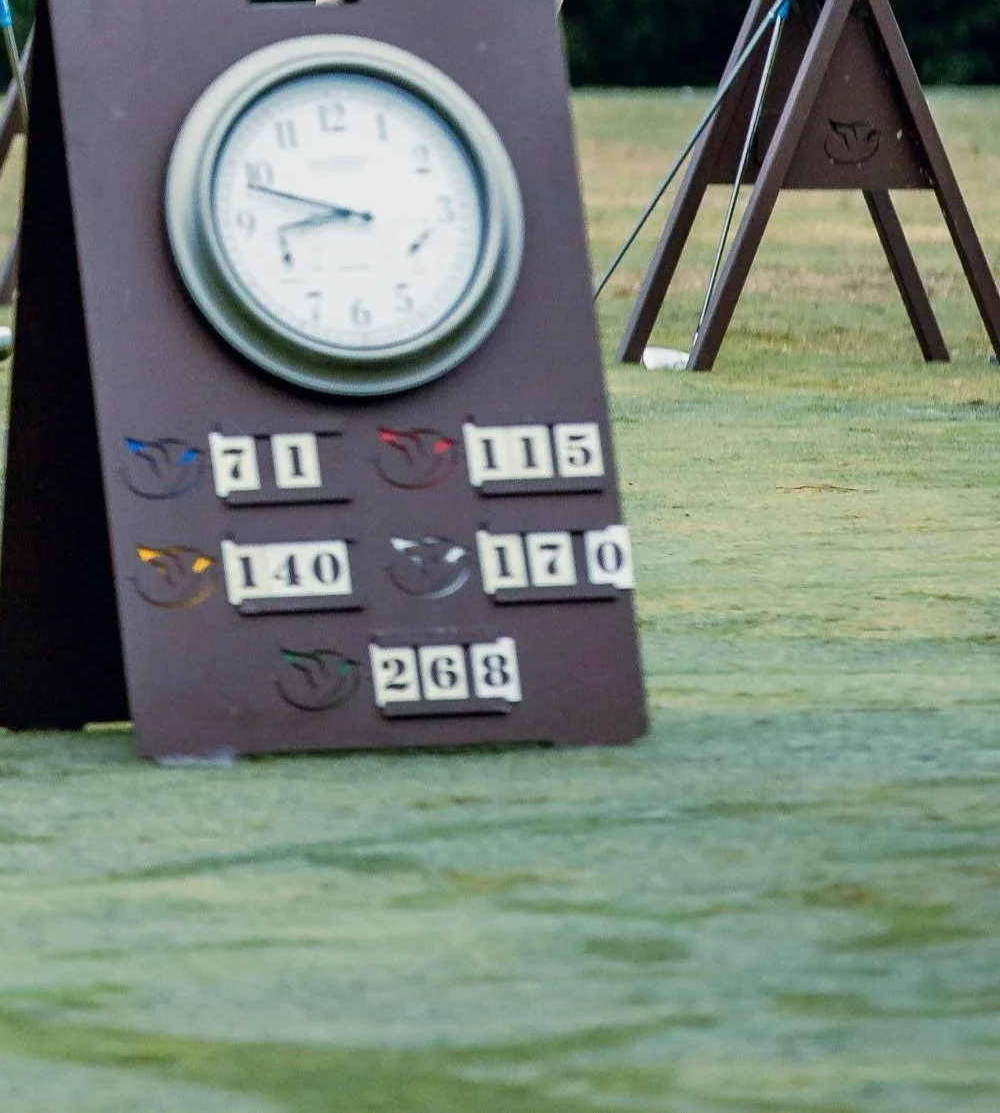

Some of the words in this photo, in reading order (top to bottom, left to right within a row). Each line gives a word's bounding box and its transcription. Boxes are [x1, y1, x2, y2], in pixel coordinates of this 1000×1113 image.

[316, 102, 348, 132] 12
[376, 112, 389, 143] 1
[274, 120, 298, 150] 11
[411, 143, 432, 175] 2
[236, 211, 257, 240] 9
[350, 297, 373, 327] 6
[220, 446, 306, 480] 71
[480, 434, 591, 471] 115
[236, 552, 341, 589] 140
[494, 542, 623, 578] 170
[381, 653, 509, 690] 268
